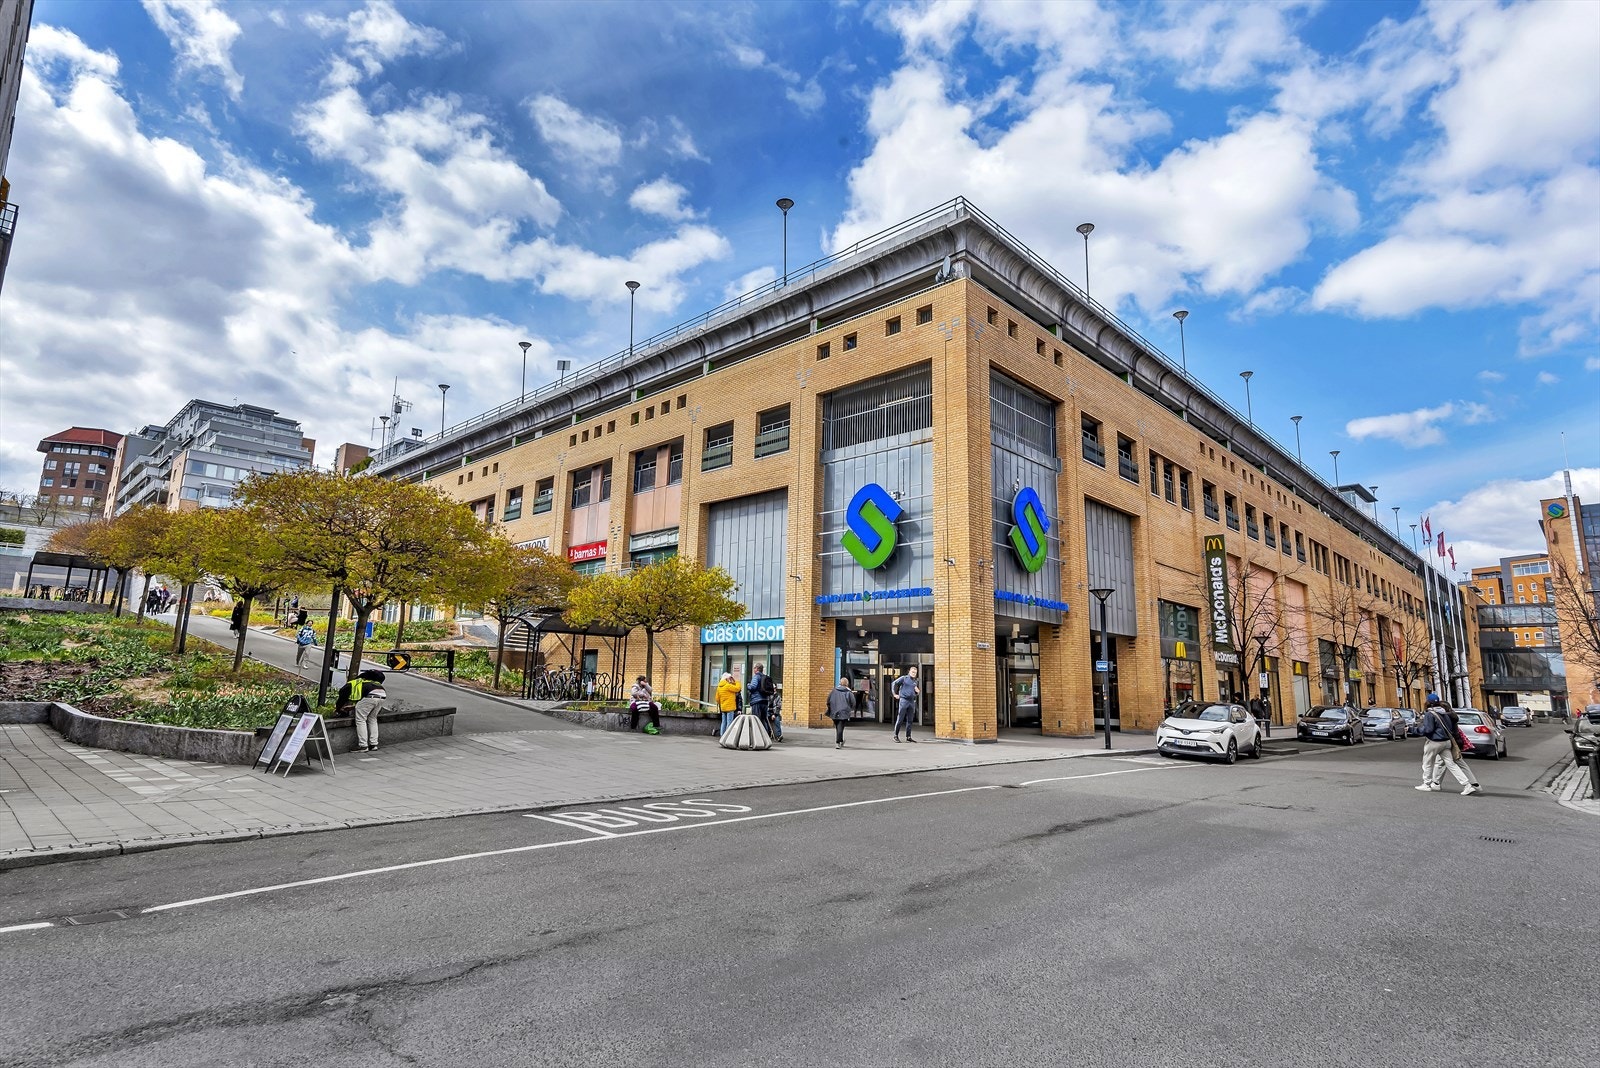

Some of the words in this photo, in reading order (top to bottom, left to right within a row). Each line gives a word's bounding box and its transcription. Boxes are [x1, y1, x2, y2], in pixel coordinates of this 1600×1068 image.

[574, 549, 597, 560] barnas
[815, 592, 863, 604] SANDVIKA
[871, 587, 934, 600] STORSENTER
[1210, 556, 1228, 644] McDonald's
[705, 623, 733, 642] clas
[736, 621, 784, 641] ohlson
[549, 798, 752, 829] BUSS
